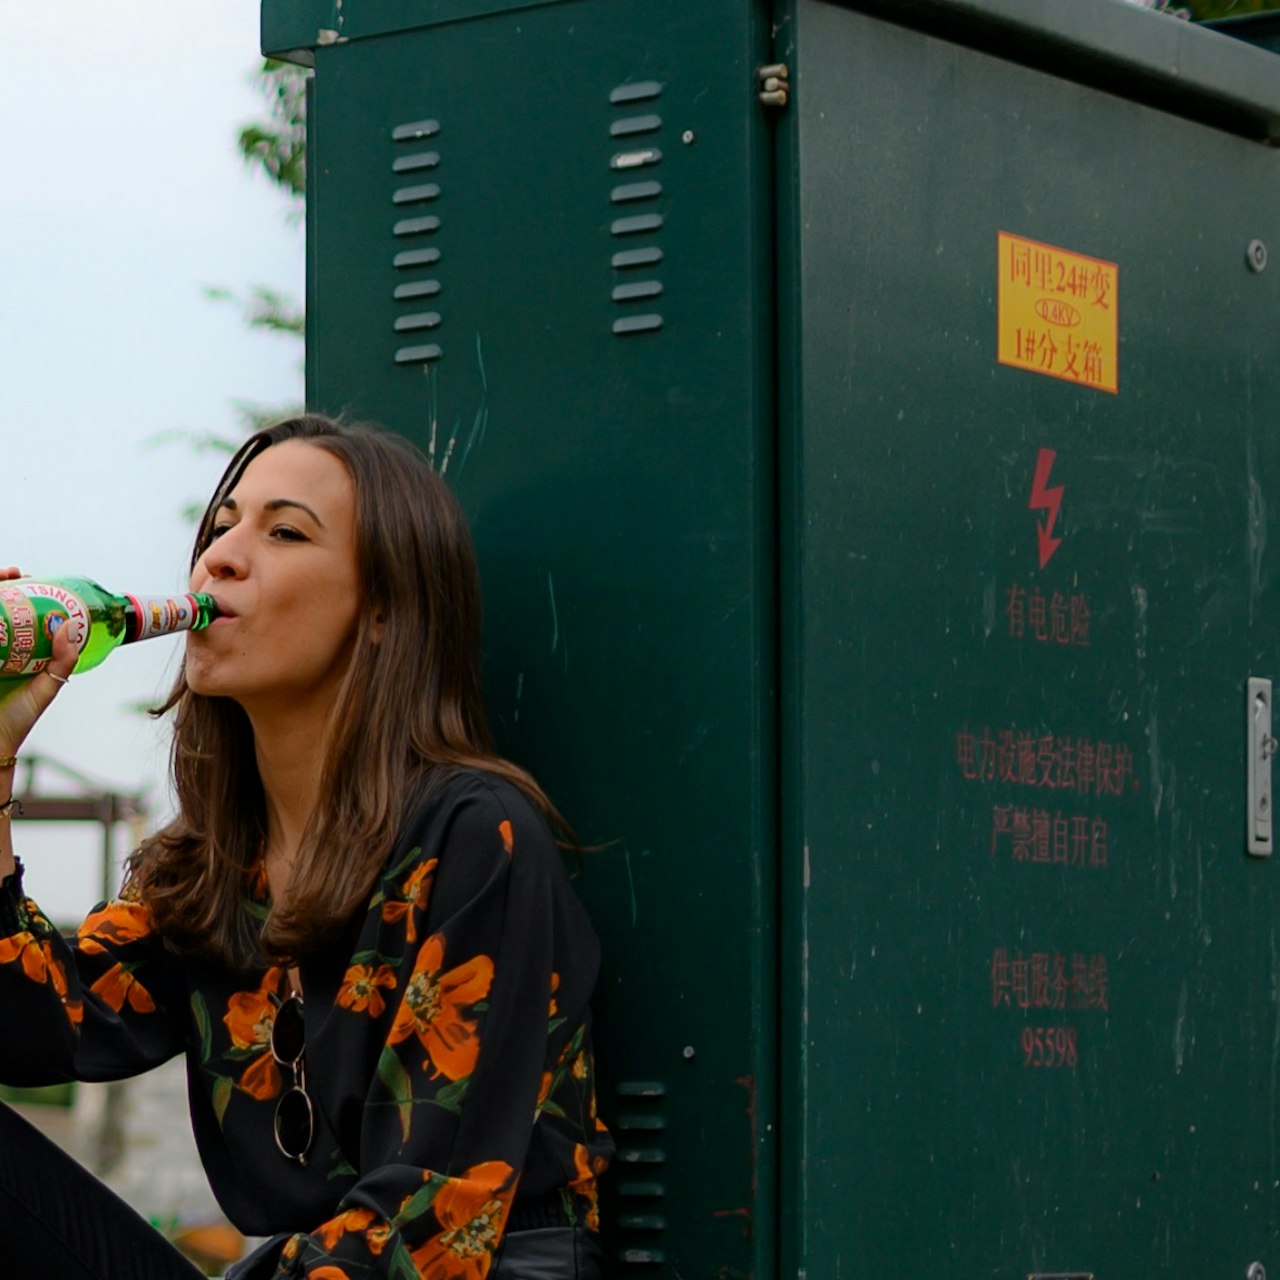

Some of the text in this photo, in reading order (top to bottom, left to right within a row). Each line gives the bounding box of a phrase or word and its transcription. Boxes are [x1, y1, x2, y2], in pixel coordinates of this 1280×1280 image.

[1010, 241, 1111, 311] 同里24#变
[1015, 327, 1104, 384] 1#分支箱
[1006, 581, 1091, 648] 有电危险
[992, 806, 1108, 869] 严禁擅自开启
[991, 947, 1109, 1012] 供电服务热线
[1020, 1026, 1079, 1067] 95598
